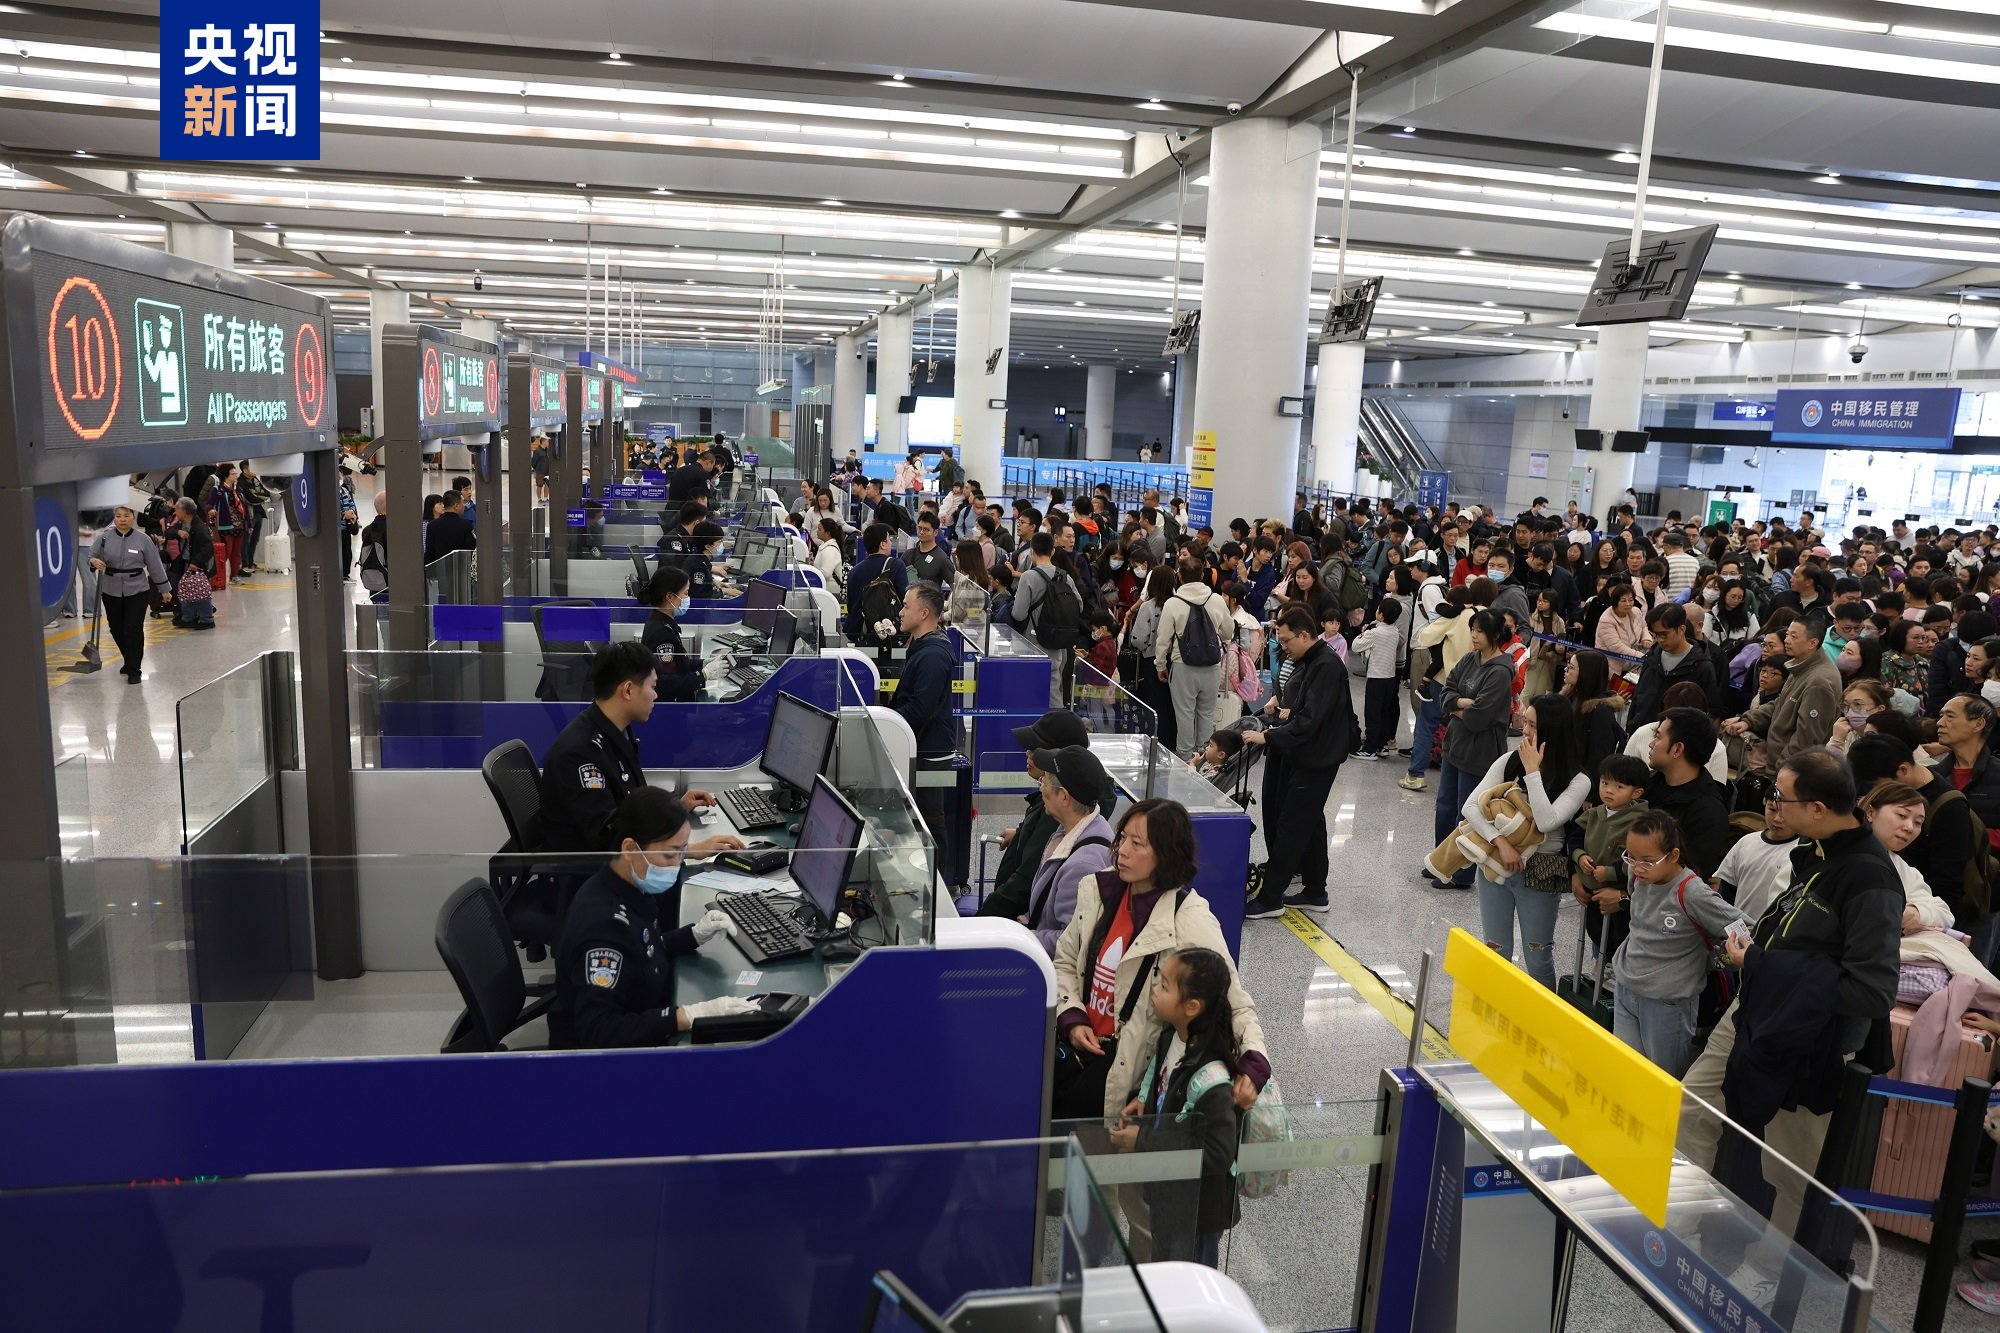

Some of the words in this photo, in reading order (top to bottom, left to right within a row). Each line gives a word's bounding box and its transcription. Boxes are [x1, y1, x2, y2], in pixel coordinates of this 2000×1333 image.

[65, 315, 106, 400] 10
[203, 312, 286, 376] 所有旅客
[304, 349, 315, 402] 9
[207, 392, 224, 424] All
[225, 393, 287, 429] Passengers
[1830, 400, 1919, 417] 中国移民管理
[1831, 419, 1855, 428] CHINA
[1858, 420, 1913, 429] IMMIGRATION
[301, 478, 308, 509] 9
[35, 525, 63, 578] 10
[1677, 1278, 1705, 1310] CHINA
